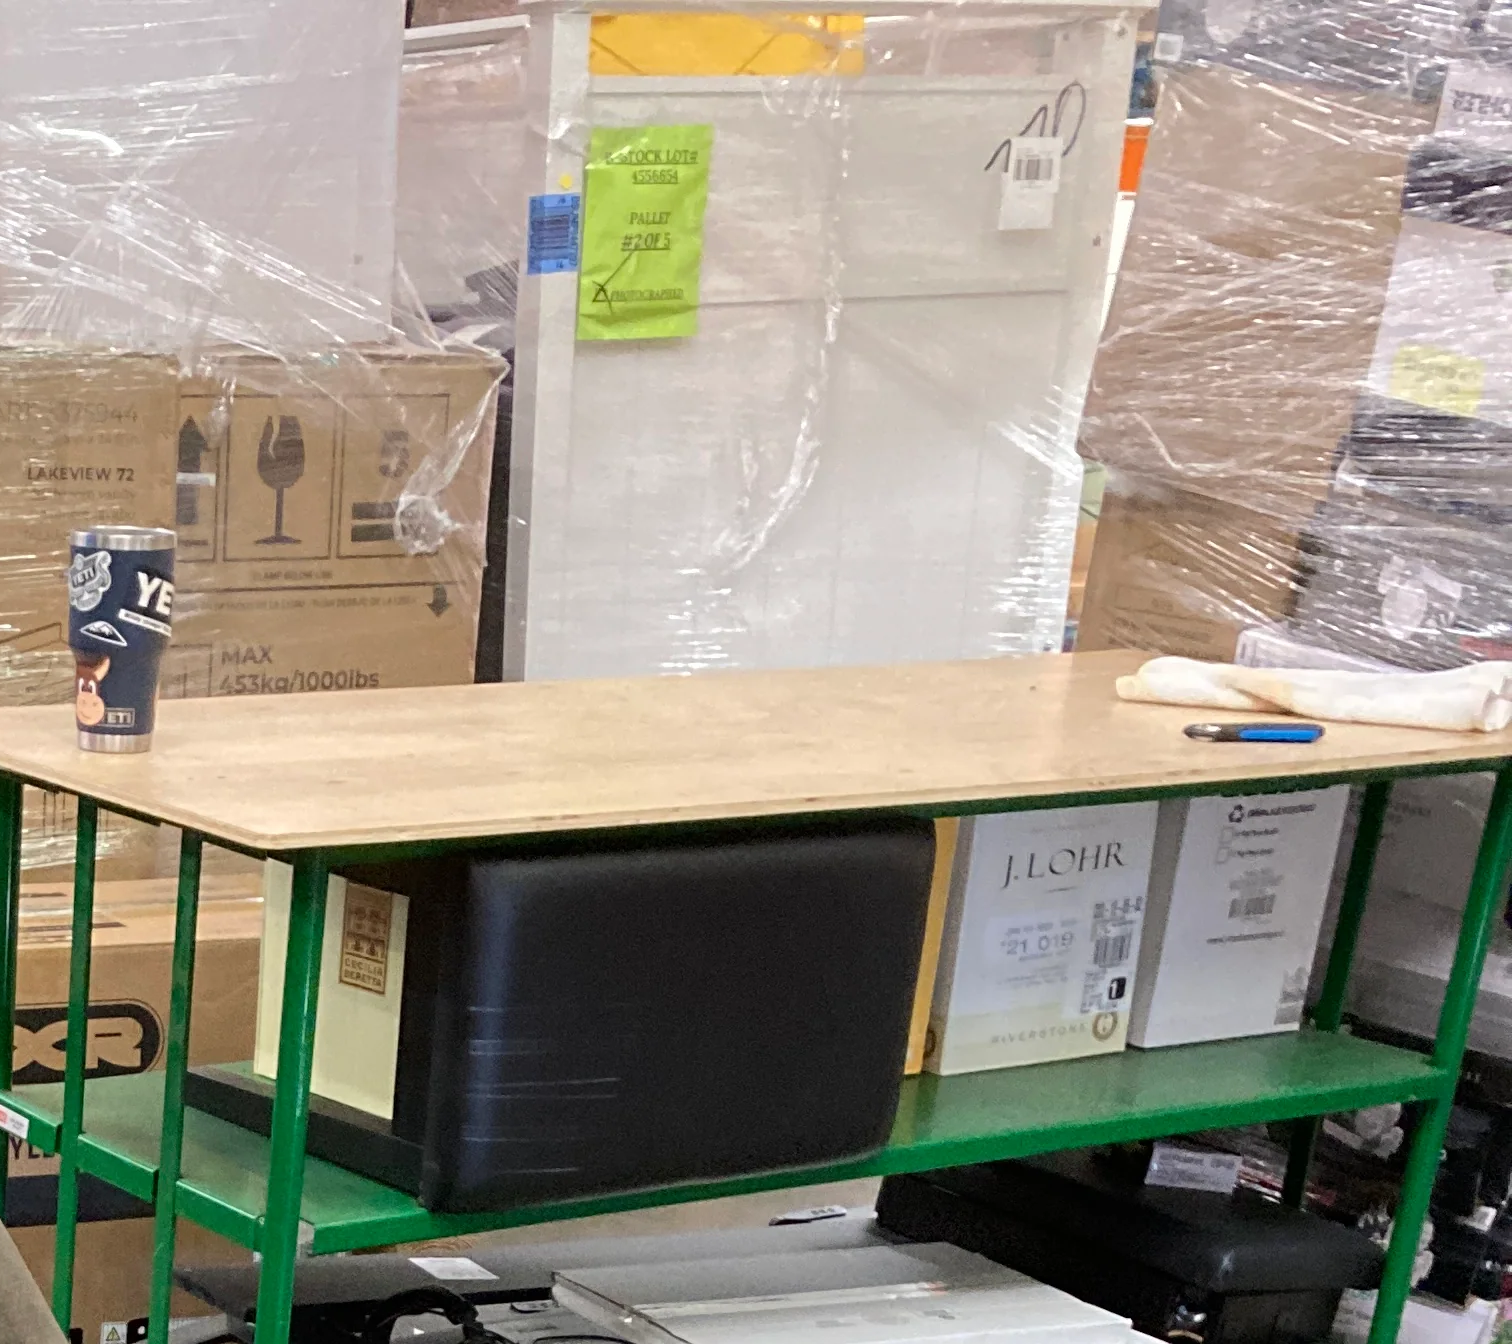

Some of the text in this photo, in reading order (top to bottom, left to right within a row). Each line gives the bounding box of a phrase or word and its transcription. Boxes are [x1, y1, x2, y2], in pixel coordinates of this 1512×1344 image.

[629, 211, 672, 226] PALLET
[27, 466, 135, 482] LAKEVIEW 72
[72, 567, 95, 588] YETI
[221, 645, 274, 665] MAX
